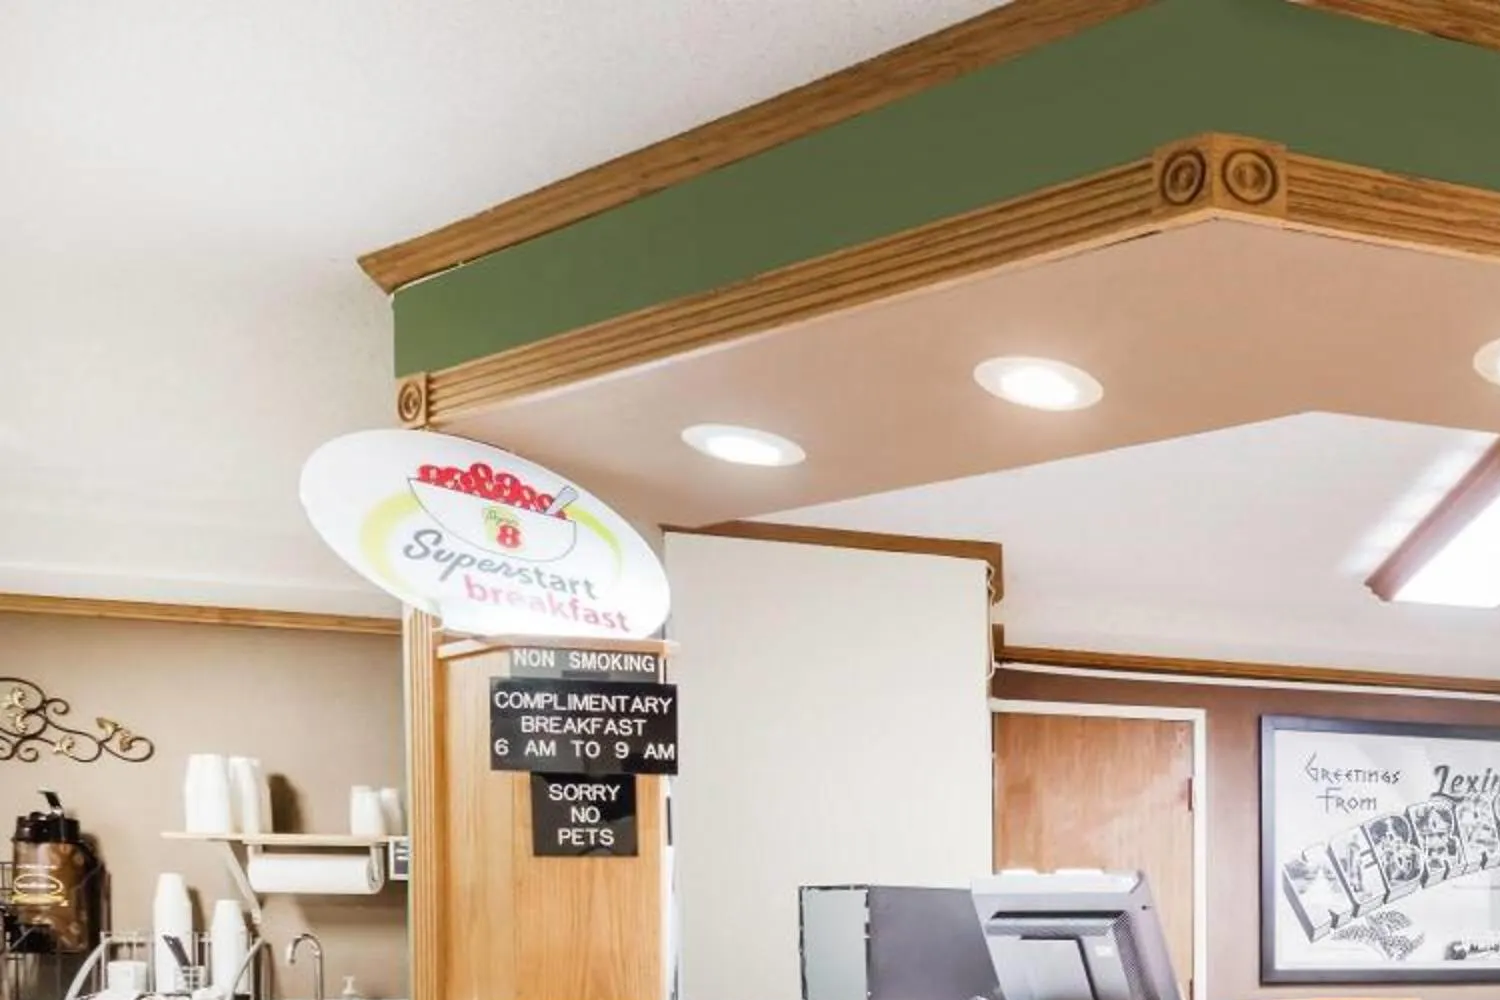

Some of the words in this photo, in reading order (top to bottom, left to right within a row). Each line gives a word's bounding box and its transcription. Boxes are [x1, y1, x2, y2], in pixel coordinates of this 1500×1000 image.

[464, 574, 630, 632] breakfast
[513, 650, 555, 668] NON
[569, 652, 655, 673] SMOKING
[494, 691, 672, 715] COMPLIMENTARY
[521, 715, 647, 736] BREAKFAST
[494, 738, 509, 755] 6
[524, 740, 556, 756] AM
[570, 741, 601, 758] TO
[615, 742, 629, 759] 9
[643, 743, 675, 760] AM
[549, 784, 621, 802] SORRY
[570, 806, 600, 823] NO
[557, 828, 614, 845] PETS
